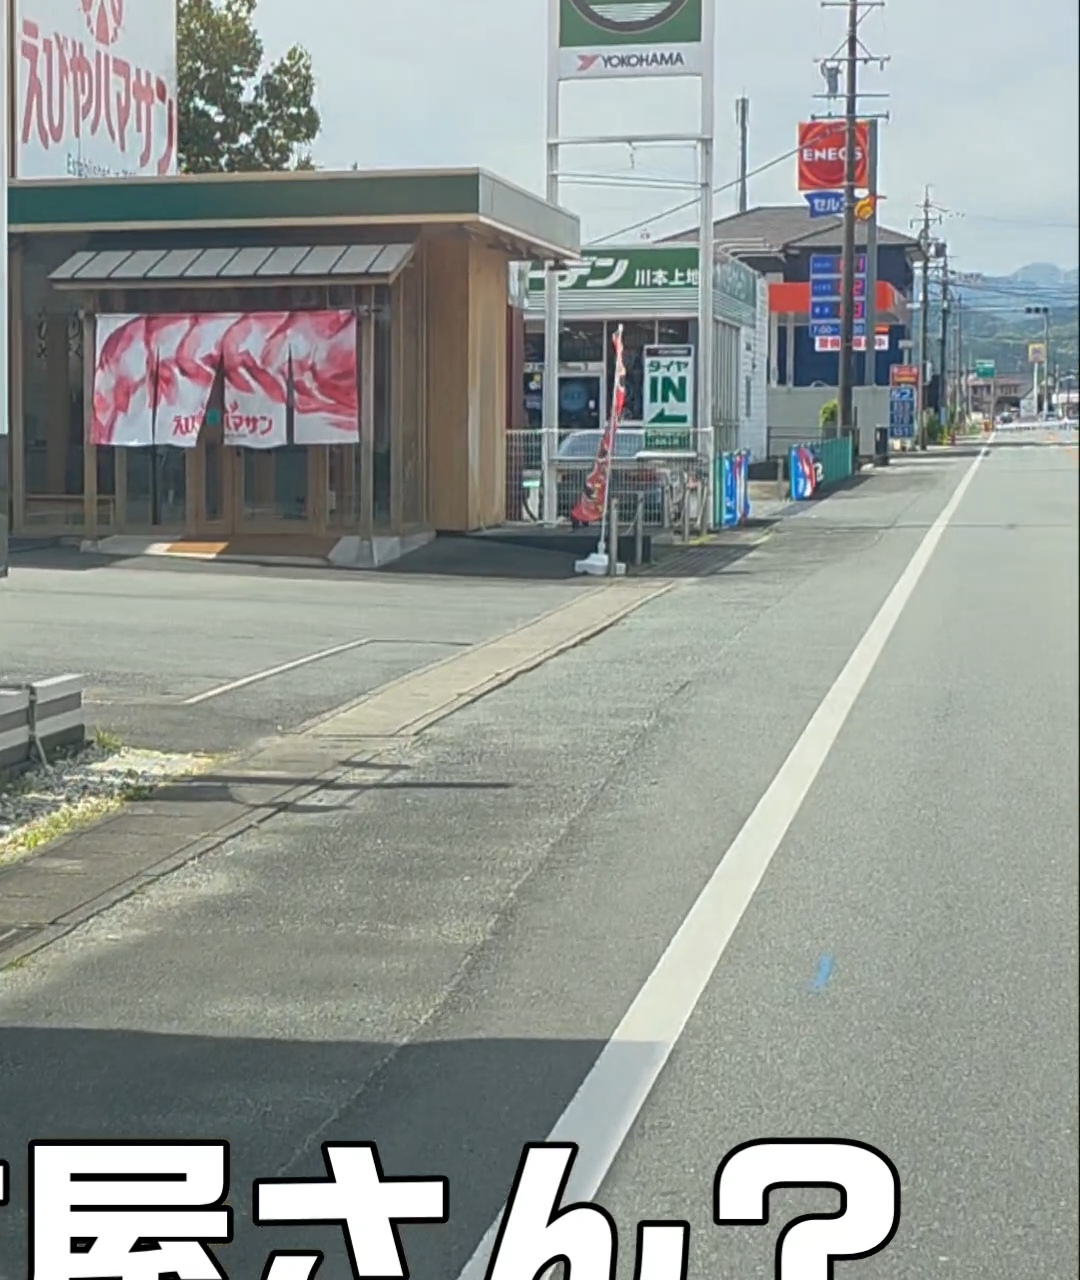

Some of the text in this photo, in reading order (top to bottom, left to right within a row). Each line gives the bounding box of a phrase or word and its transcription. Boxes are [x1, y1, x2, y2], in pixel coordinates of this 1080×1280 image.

[602, 52, 685, 69] YOKOHAMA
[20, 18, 175, 176] えびやハマサン
[650, 376, 687, 404] IN
